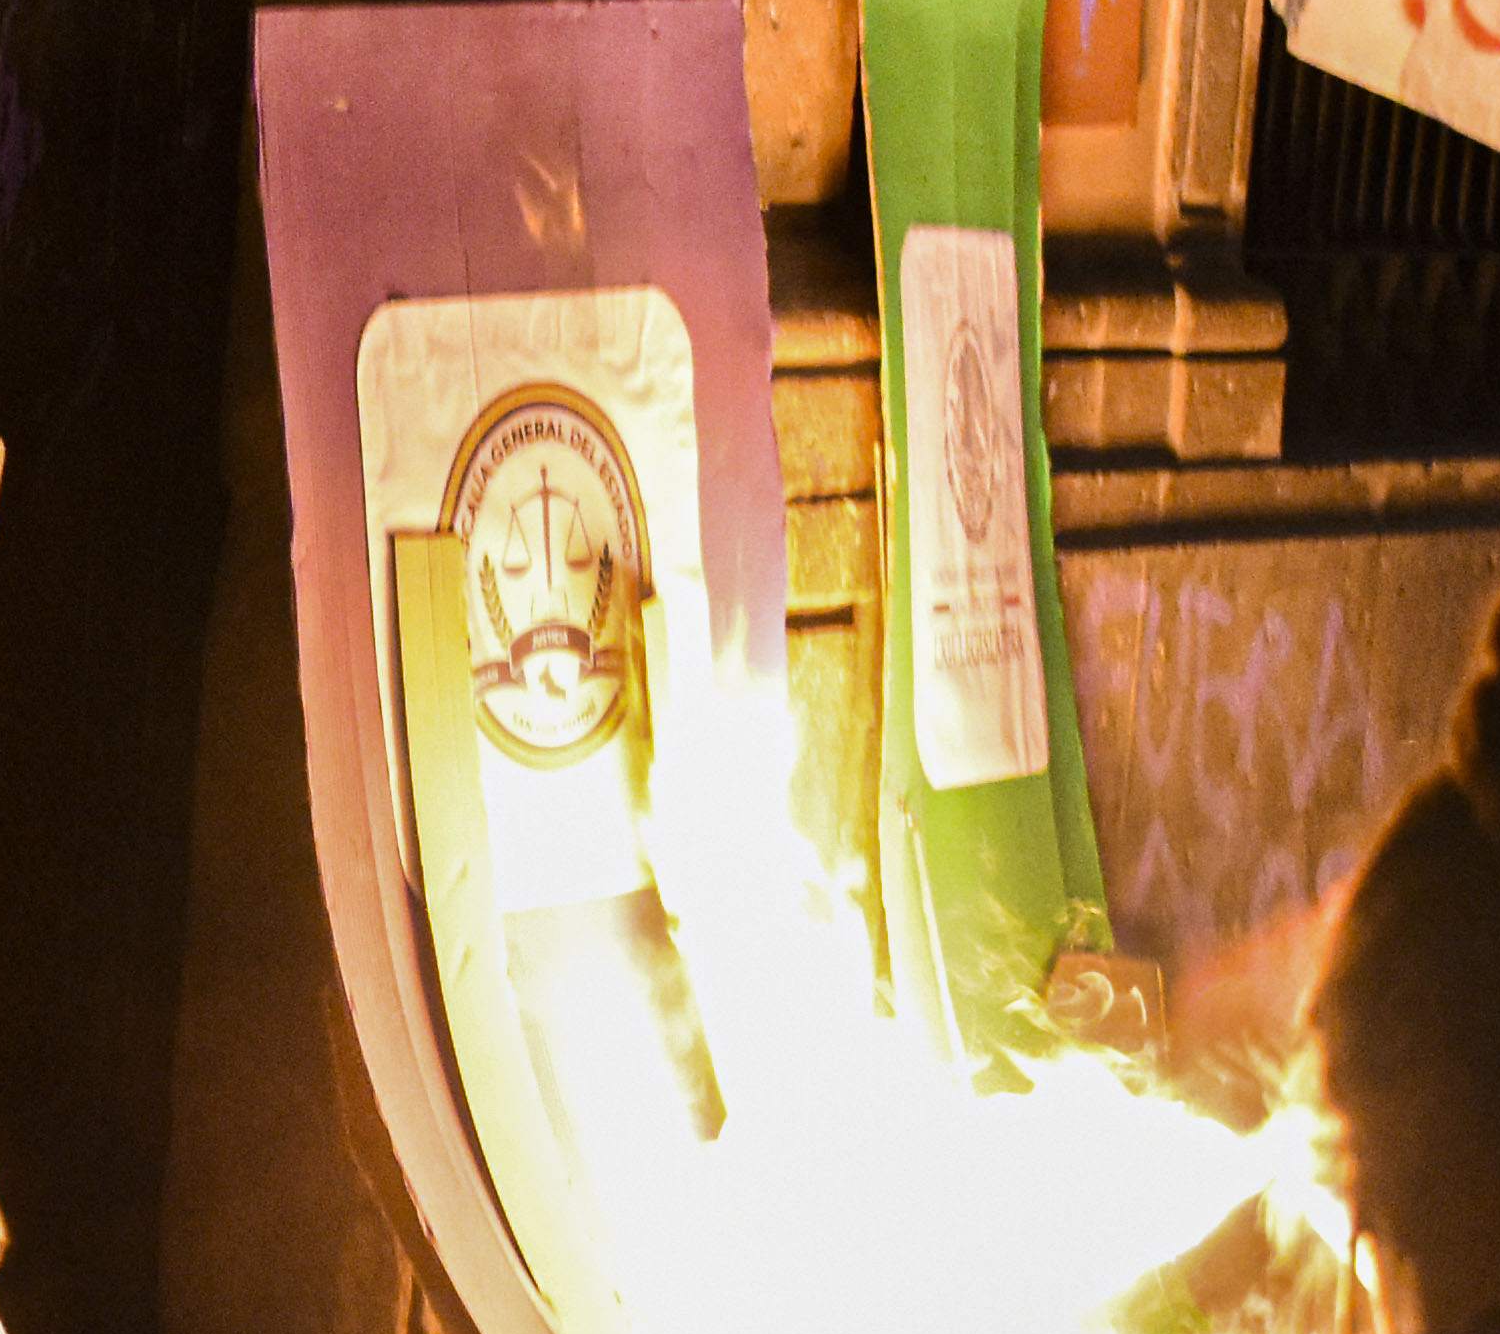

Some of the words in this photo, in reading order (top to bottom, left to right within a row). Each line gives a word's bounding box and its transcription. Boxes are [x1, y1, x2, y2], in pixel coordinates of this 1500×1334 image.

[490, 419, 565, 467] GENERAL
[568, 425, 597, 467] DEL
[598, 455, 634, 560] ESTADO
